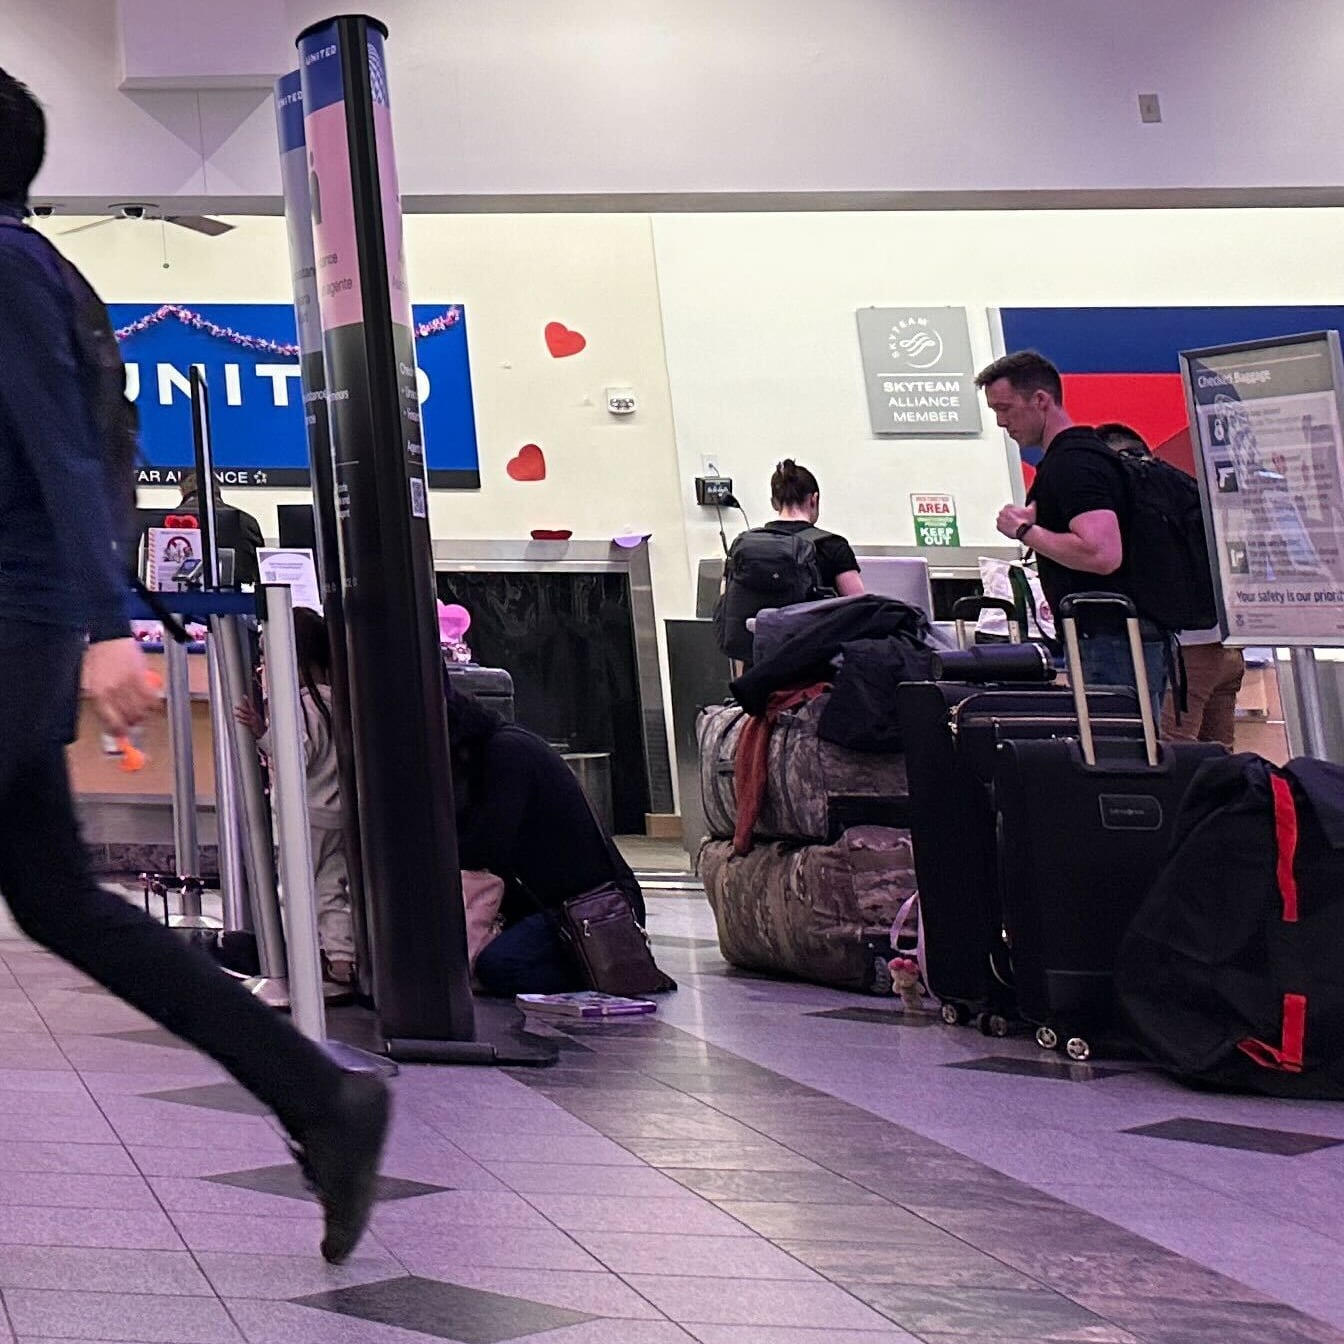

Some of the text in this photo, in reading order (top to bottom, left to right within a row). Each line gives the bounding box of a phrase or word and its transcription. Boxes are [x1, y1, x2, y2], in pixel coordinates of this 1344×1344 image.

[304, 44, 338, 66] UNITED
[888, 316, 928, 359] SKYTEAM
[883, 381, 960, 393] SKYTEAM
[888, 396, 961, 408] ALLIANCE
[893, 411, 960, 422] MEMBER
[918, 503, 950, 514] AREA
[919, 527, 954, 537] KEEP
[924, 535, 952, 546] OUT
[1236, 588, 1344, 604] Your safety is our priorit
